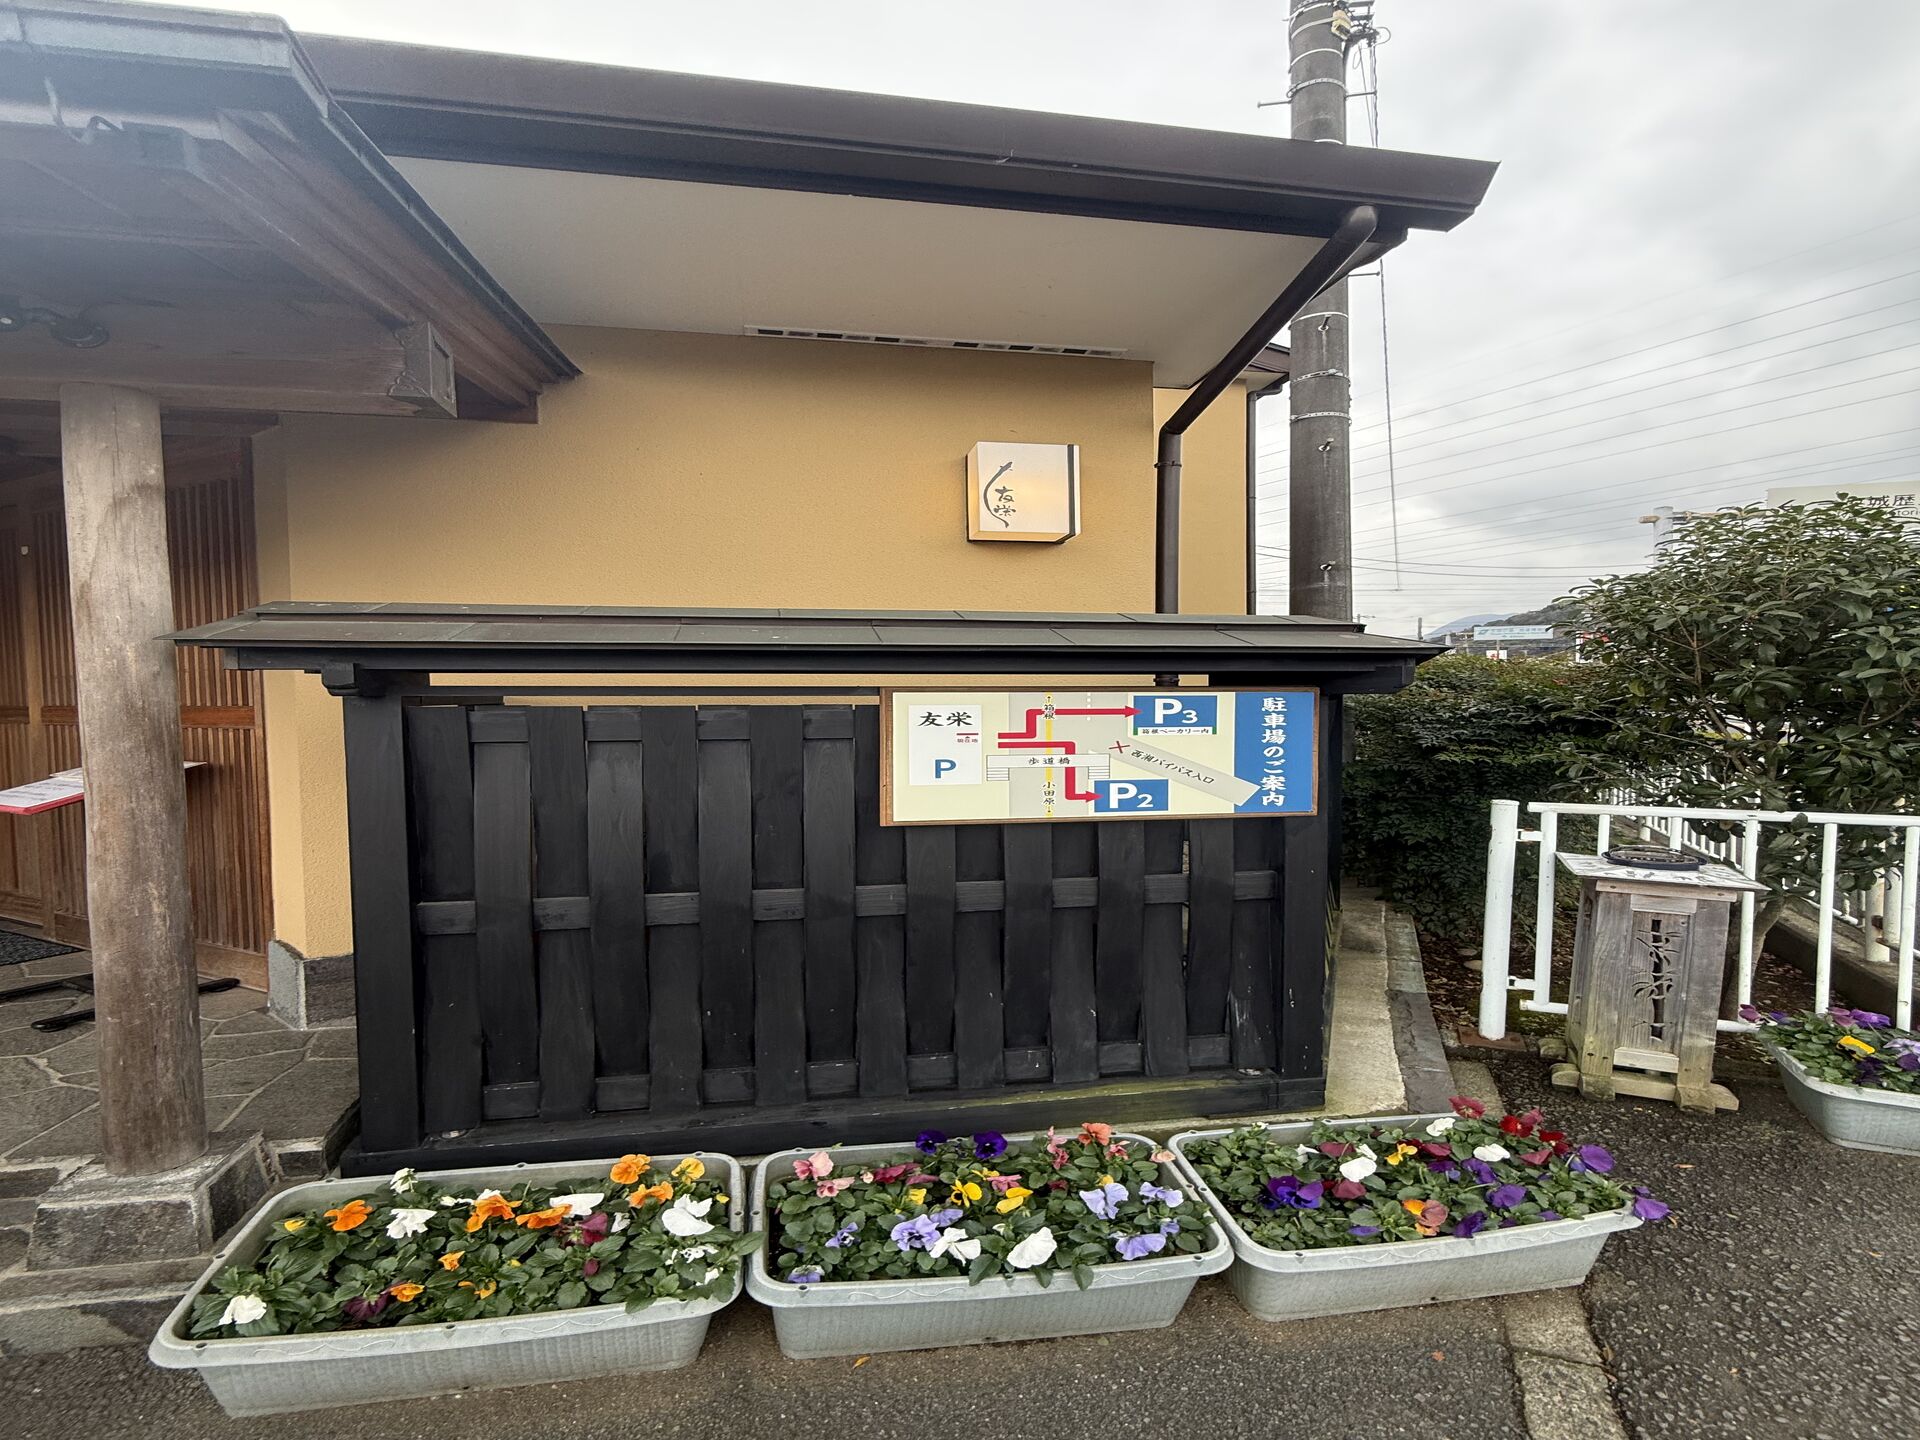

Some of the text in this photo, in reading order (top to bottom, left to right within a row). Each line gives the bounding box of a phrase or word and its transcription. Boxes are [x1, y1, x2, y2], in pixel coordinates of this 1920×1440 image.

[917, 711, 973, 727] 友栄
[1028, 756, 1070, 765] 歩道橋
[1260, 697, 1288, 807] 駐車場のご案内
[934, 759, 957, 779] P
[1131, 749, 1215, 784] 西湘バイパス入口
[1042, 781, 1056, 805] 小田原
